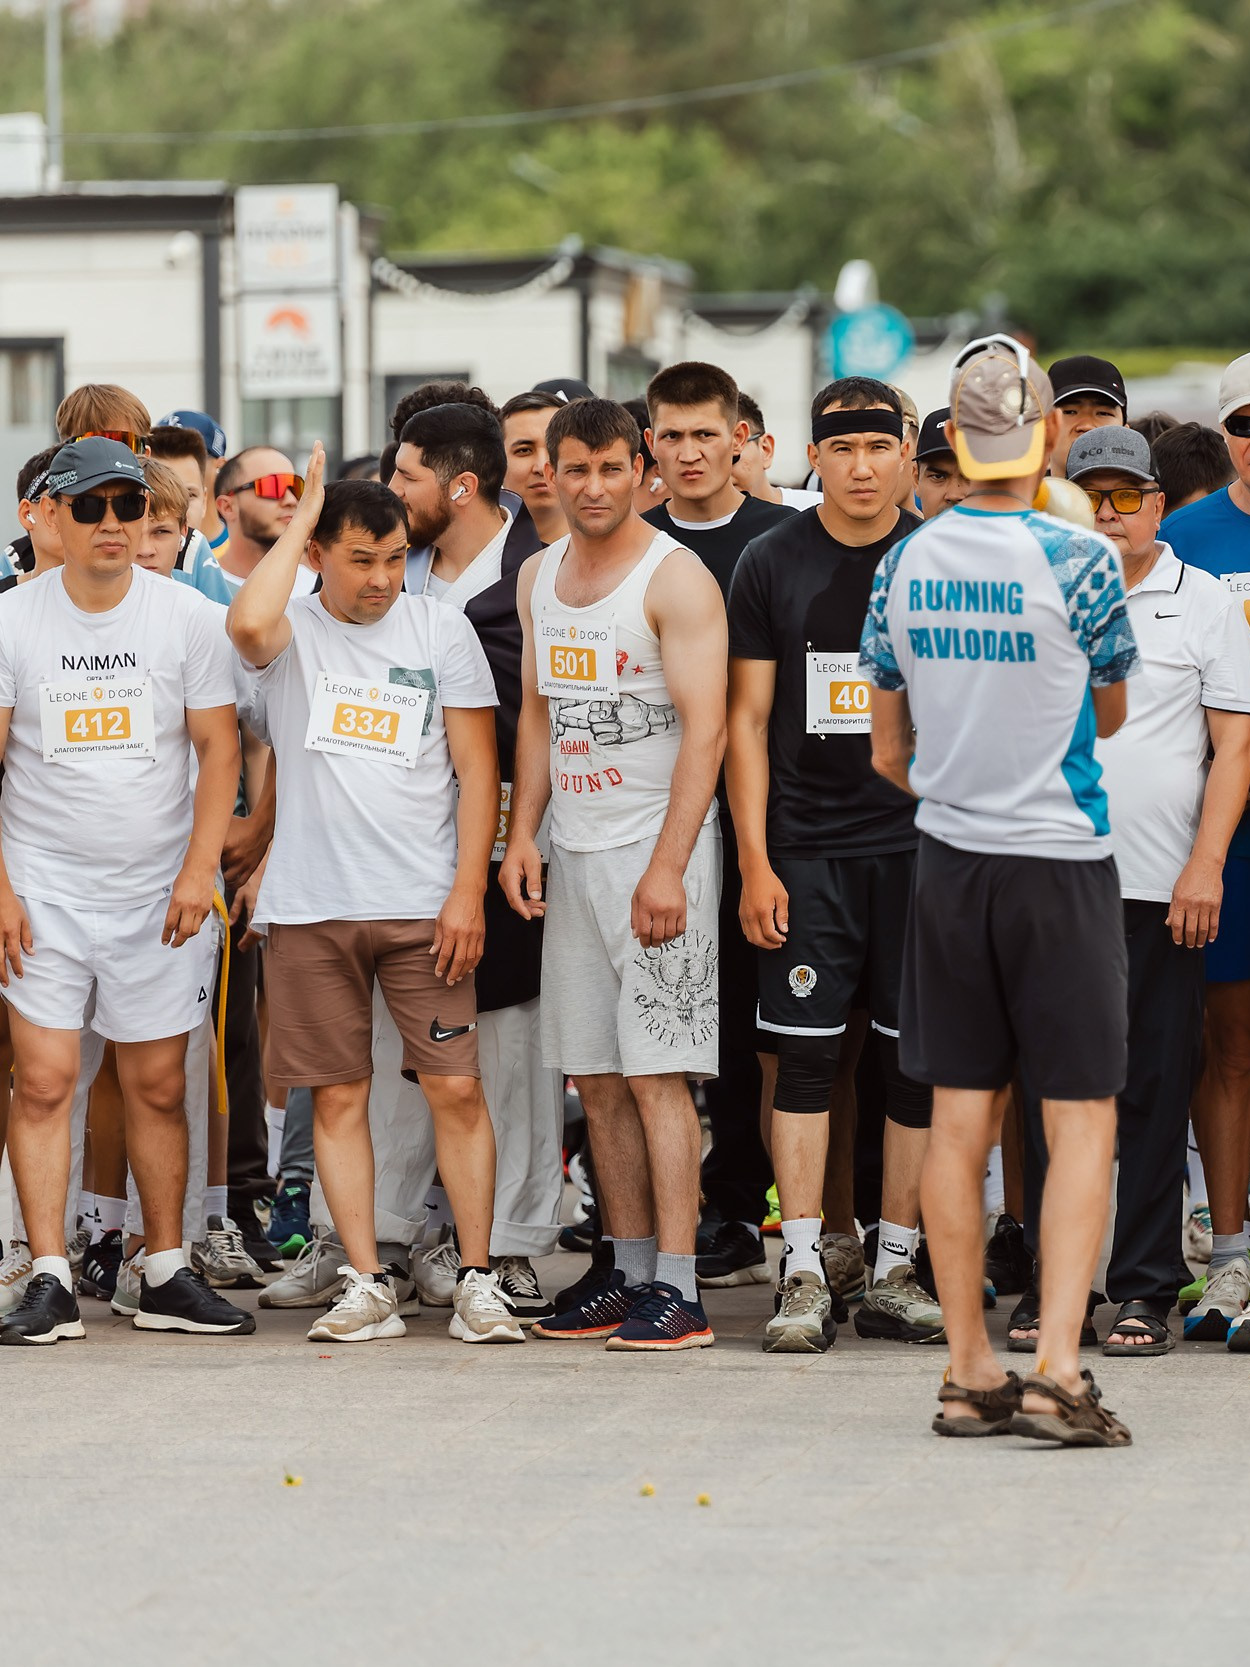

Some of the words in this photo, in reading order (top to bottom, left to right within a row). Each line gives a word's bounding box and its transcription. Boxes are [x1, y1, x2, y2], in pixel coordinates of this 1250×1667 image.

[909, 579, 1024, 615] RUNNING
[542, 626, 566, 638] LEONE
[580, 630, 608, 641] D'ORO
[61, 652, 136, 671] NAIMAN
[554, 650, 589, 677] 501
[816, 663, 853, 673] LEONE
[49, 691, 88, 702] LEONE
[108, 688, 143, 699] D'ORO
[325, 683, 364, 698] LEONE
[383, 693, 417, 707] D'ORO
[71, 711, 125, 738] 412
[339, 707, 392, 739] 334
[54, 742, 125, 754] БЛАГОТВОРИТЕЛЬНЫЙ
[317, 735, 387, 753] БЛАГОТВОРИТЕЛЬНЫЙ
[387, 749, 406, 757] ЗАБЕГ
[560, 740, 590, 753] AGAIN
[875, 1296, 908, 1314] CORDURA
